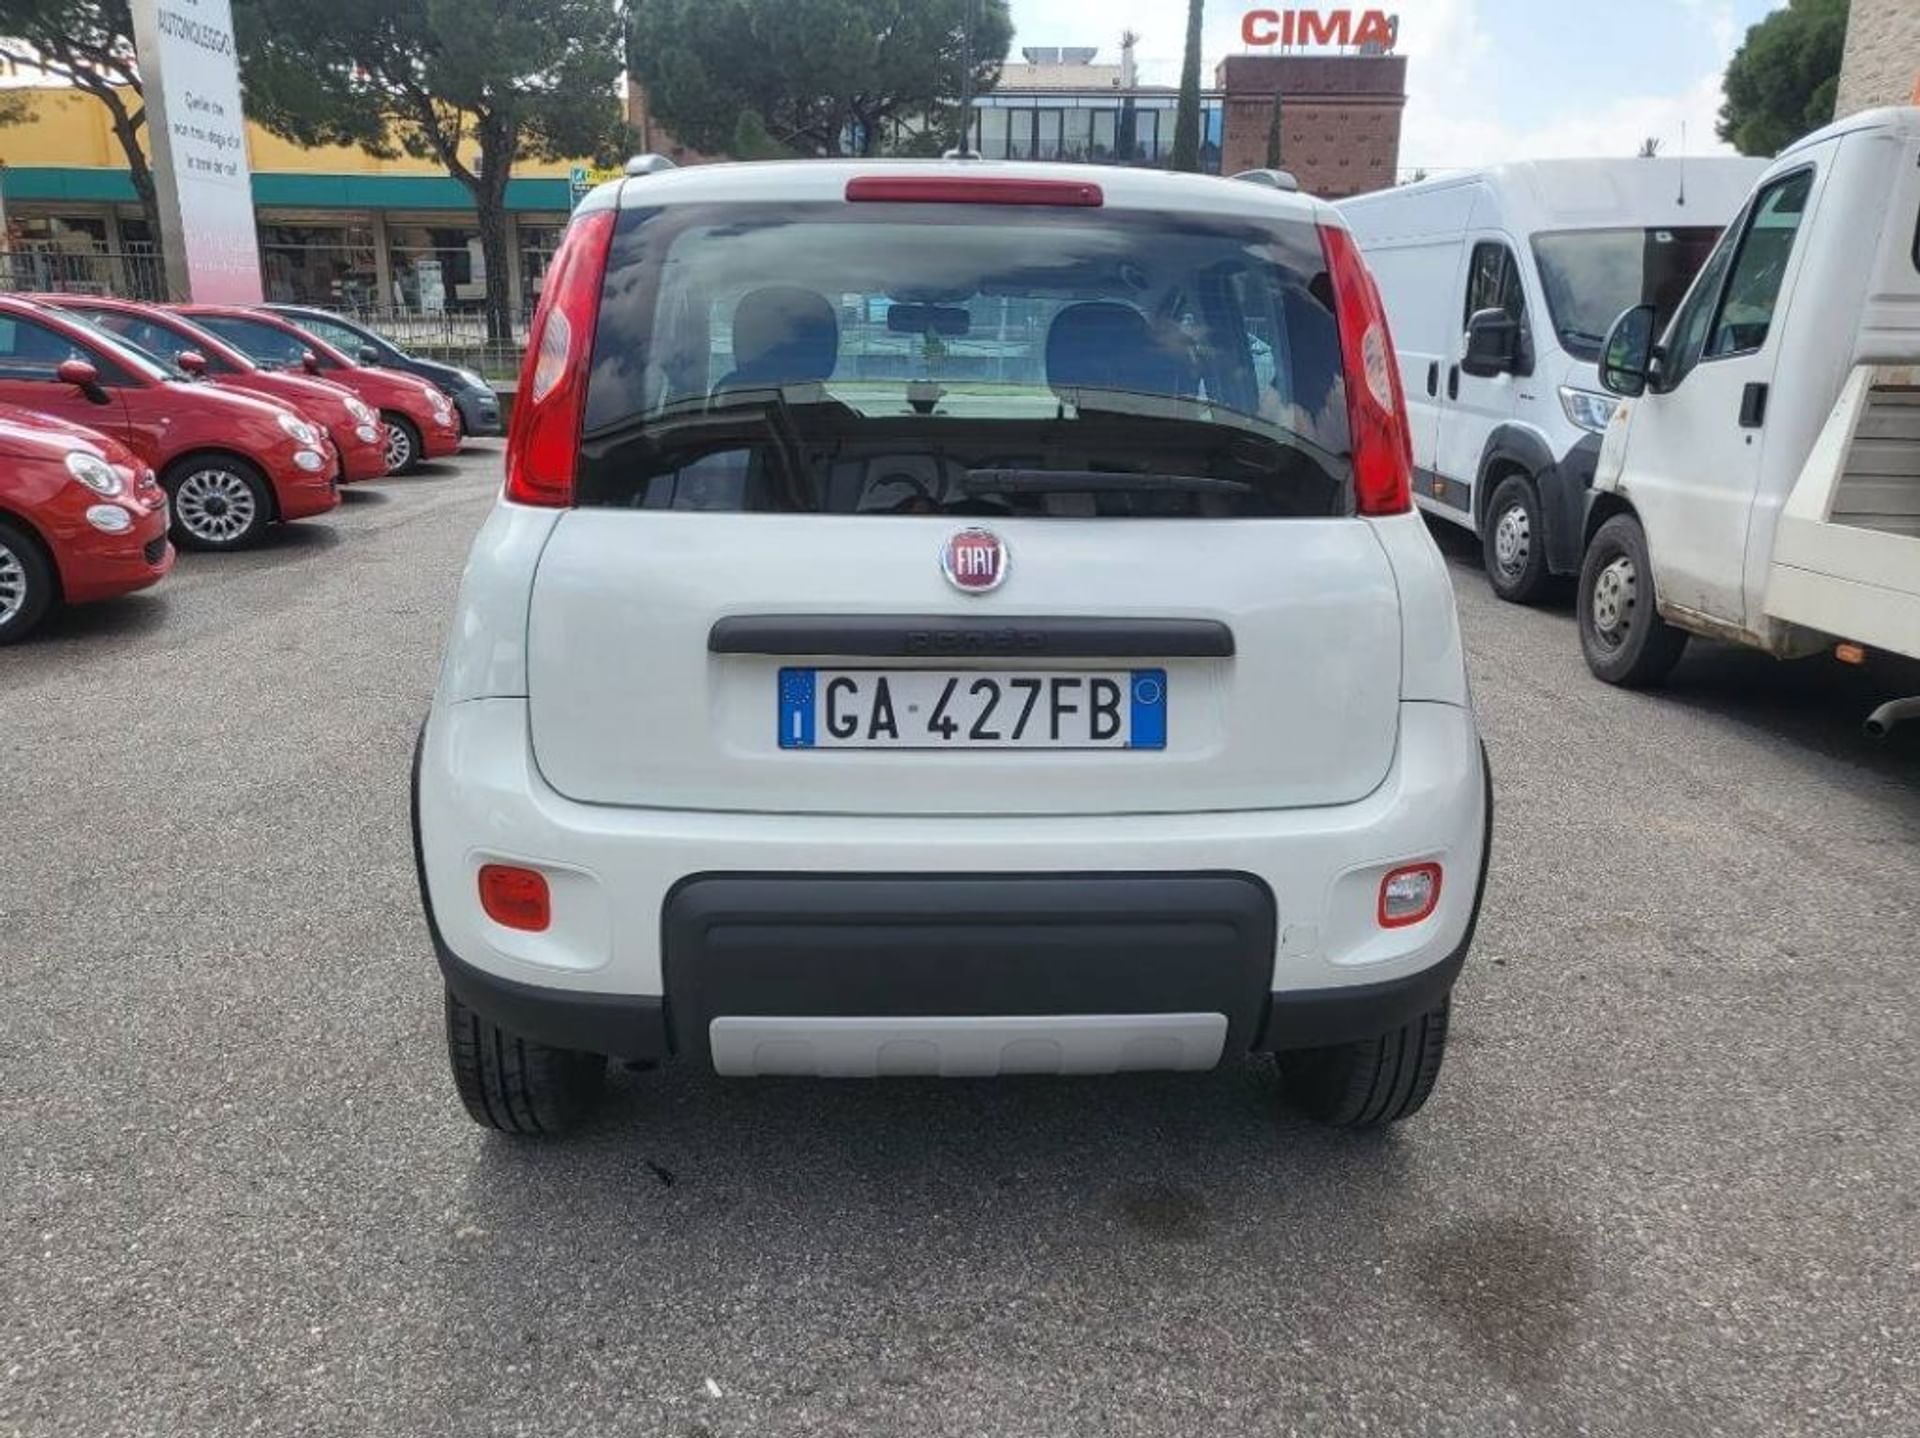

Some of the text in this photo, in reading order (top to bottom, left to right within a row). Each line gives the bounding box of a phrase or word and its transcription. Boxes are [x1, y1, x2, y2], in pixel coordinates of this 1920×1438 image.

[1241, 10, 1390, 46] CIMA
[957, 546, 996, 575] FIAT
[827, 677, 1121, 740] GA 427FB
